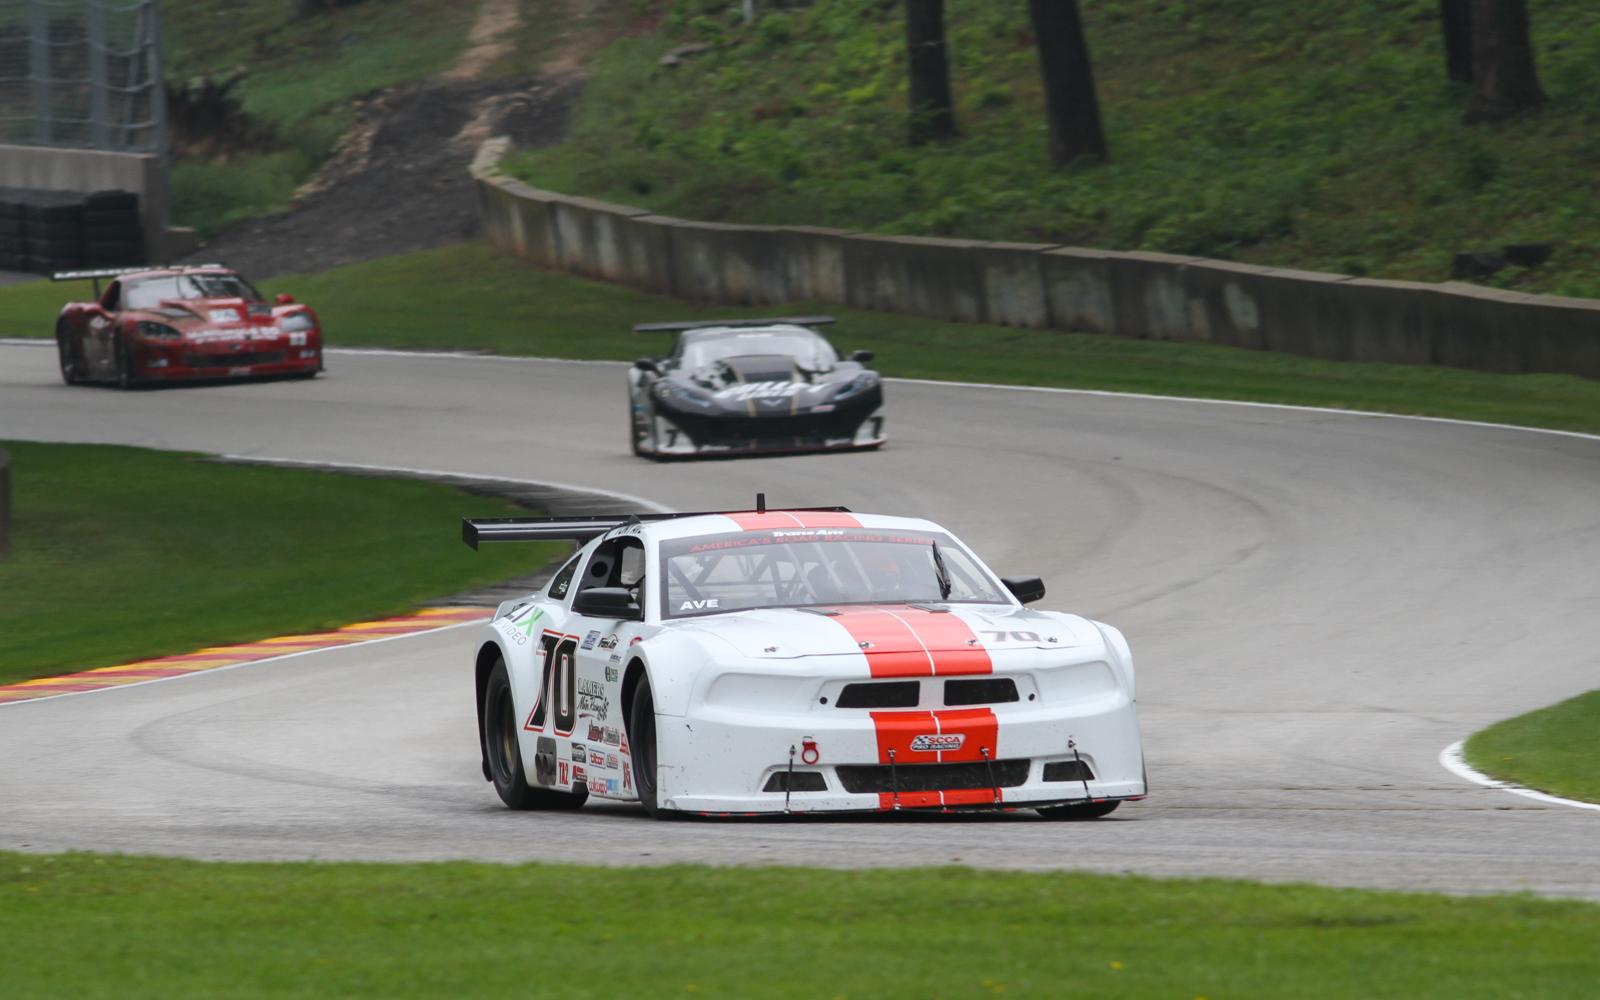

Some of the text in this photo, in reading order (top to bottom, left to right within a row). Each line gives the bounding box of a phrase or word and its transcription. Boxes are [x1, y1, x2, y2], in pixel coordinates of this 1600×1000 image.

[690, 537, 771, 553] AMERICA'S
[776, 535, 818, 544] ROAD
[824, 535, 883, 544] RACING
[680, 599, 719, 611] AVE
[980, 631, 1041, 642] 70
[523, 628, 581, 737] 70
[928, 736, 960, 744] SCCA
[558, 761, 569, 785] TA2
